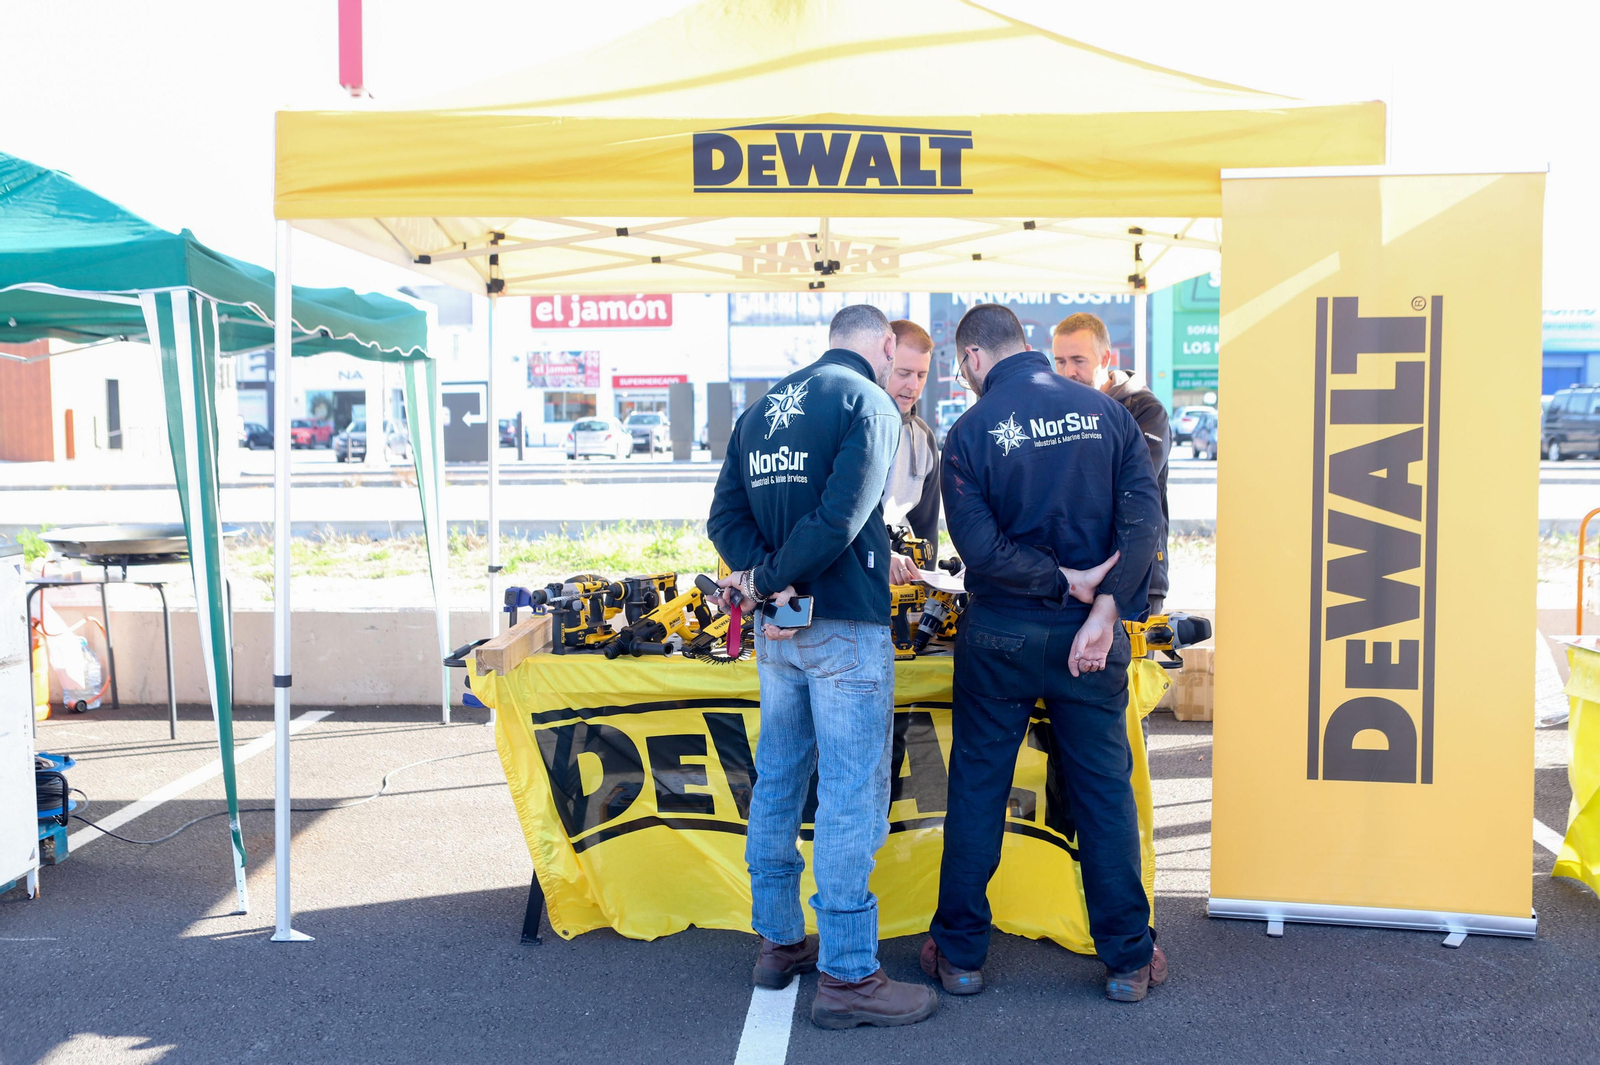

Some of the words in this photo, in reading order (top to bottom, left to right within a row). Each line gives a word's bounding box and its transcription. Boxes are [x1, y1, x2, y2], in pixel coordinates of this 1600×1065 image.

[692, 131, 974, 187] DEWALT
[535, 294, 565, 322] el
[568, 293, 668, 328] jamón
[1183, 341, 1212, 355] LOS
[338, 370, 364, 381] NA
[1029, 412, 1100, 439] NorSur
[1034, 438, 1057, 447] Industrial
[1081, 431, 1103, 440] Services
[749, 446, 809, 477] NorSur
[1322, 296, 1427, 785] DEWALT
